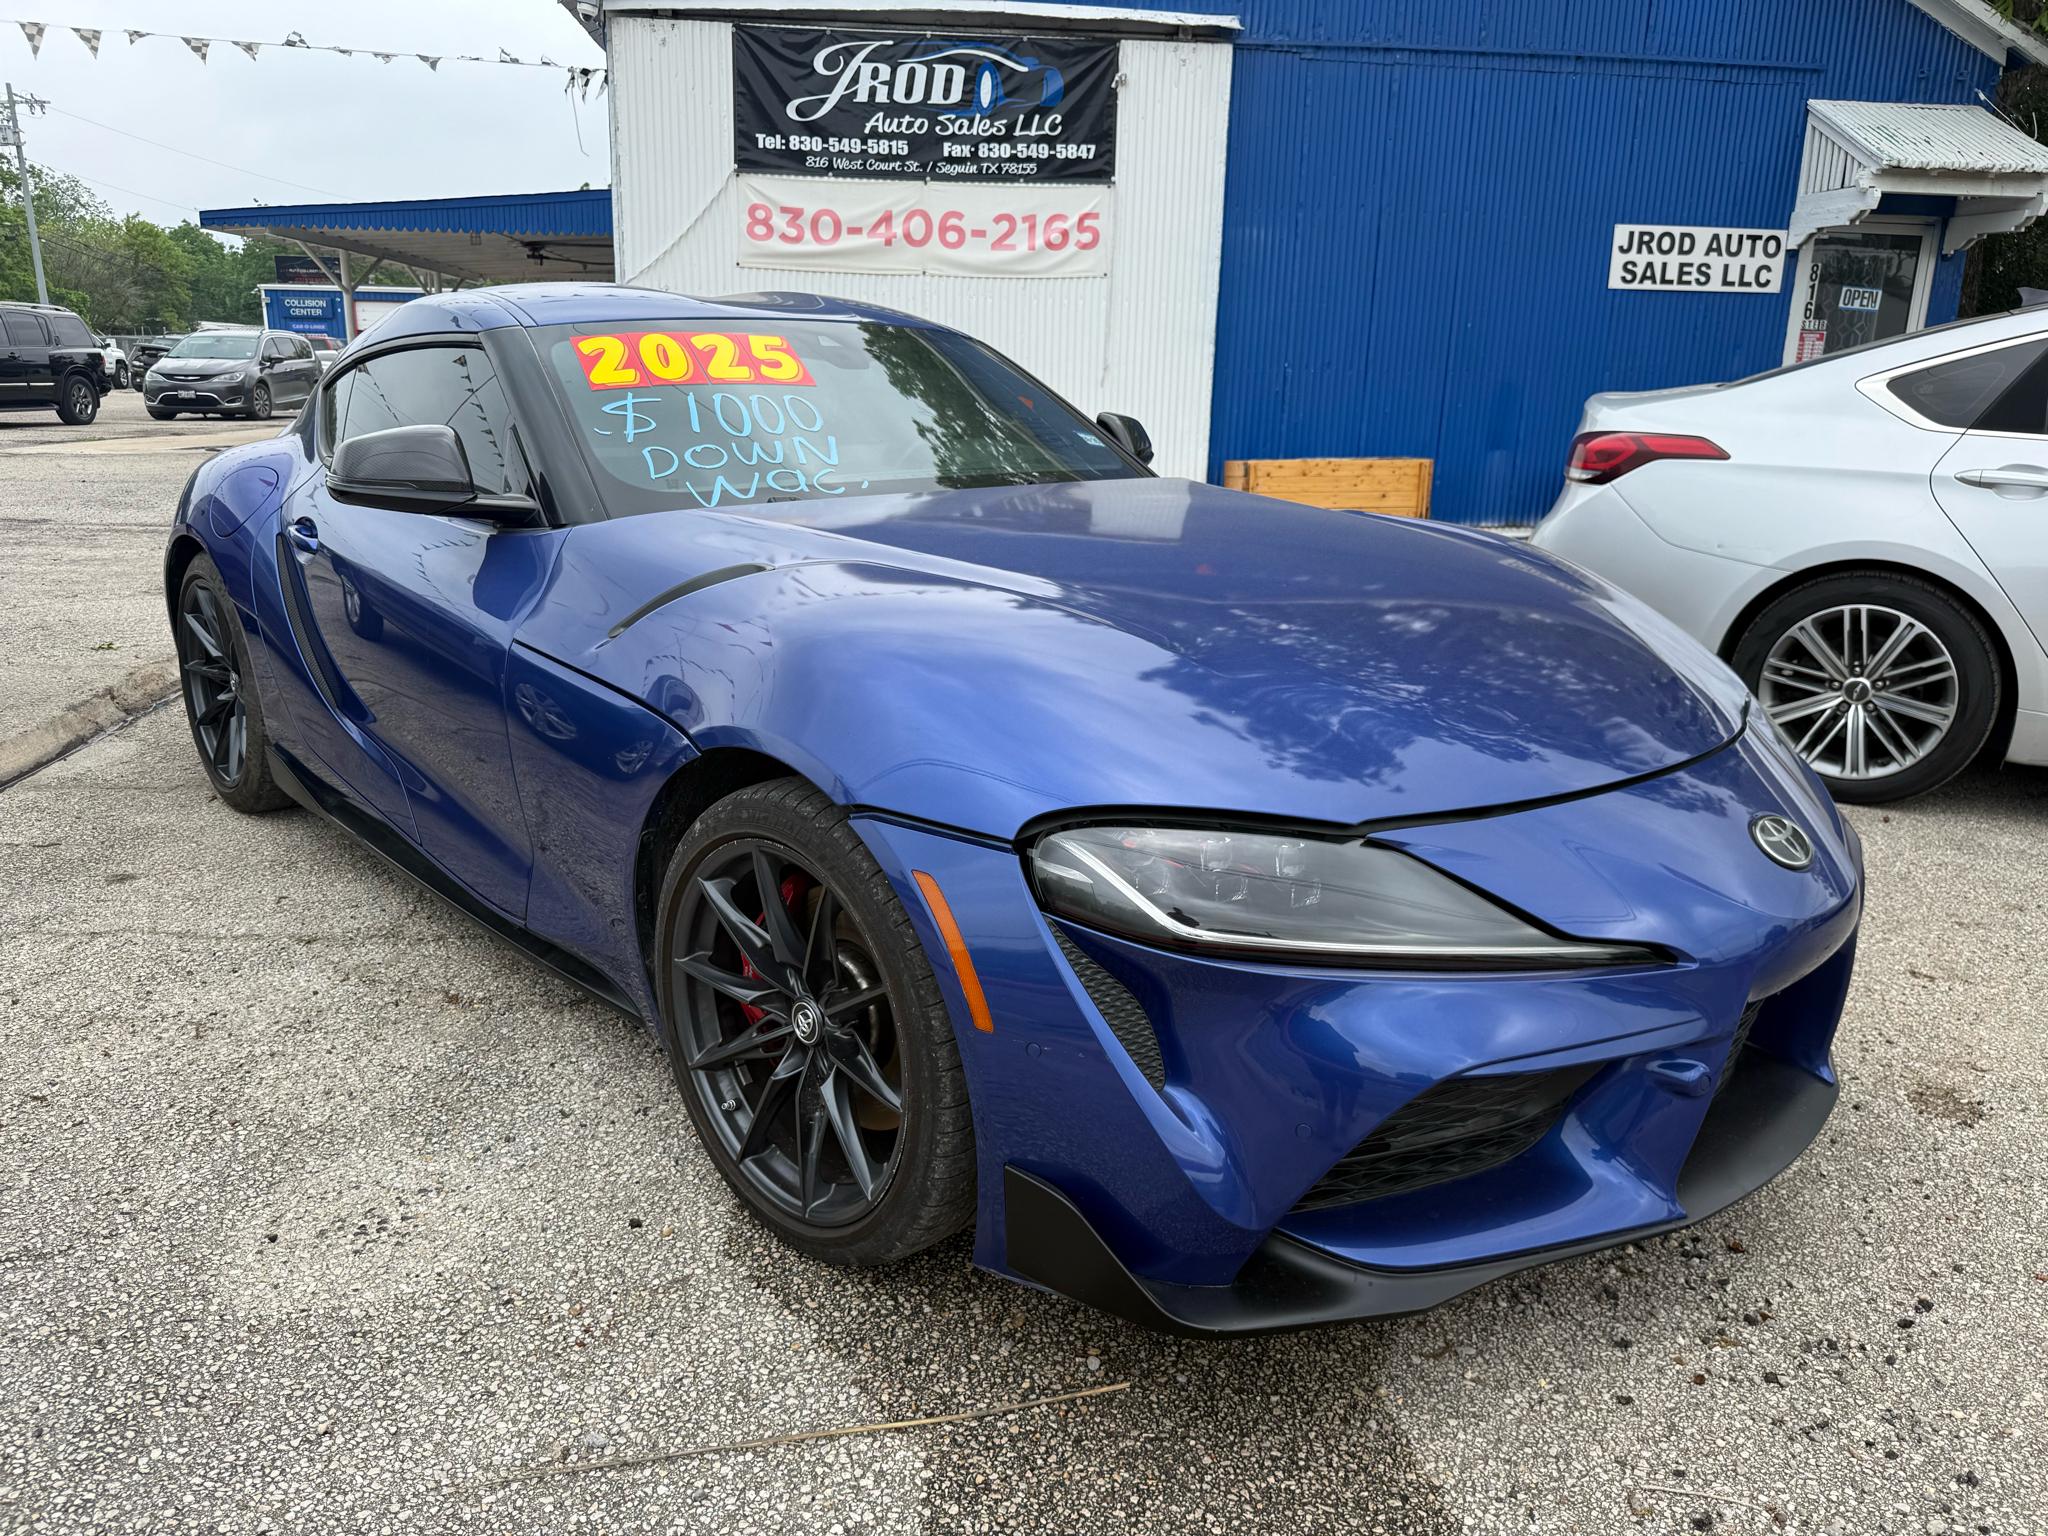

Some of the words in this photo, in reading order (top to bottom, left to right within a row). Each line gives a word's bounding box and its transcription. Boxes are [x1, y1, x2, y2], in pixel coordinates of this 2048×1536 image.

[864, 112, 929, 134] Auto
[935, 113, 1007, 136] Sales
[1013, 114, 1062, 136] LLC
[755, 133, 786, 149] Tel:
[789, 135, 909, 155] 830-549-5815
[978, 143, 1096, 159] 830-549-5847
[805, 156, 828, 168] 816
[833, 157, 863, 170] West
[866, 159, 902, 172] Court
[904, 160, 923, 172] St.
[935, 162, 978, 176] Seguin
[980, 163, 999, 174] TX
[1000, 163, 1037, 175] 78155
[746, 203, 1100, 251] 830-406-2165
[1618, 231, 1696, 256] JROD
[1704, 233, 1781, 259] AUTO
[1620, 260, 1712, 286] SALES
[1721, 263, 1773, 288] LLC
[284, 299, 326, 308] COLLISION
[1804, 263, 1820, 320] 816
[1842, 288, 1879, 309] OPEN
[290, 308, 322, 316] CENTER
[578, 333, 804, 386] 2025
[642, 436, 839, 480] DOWN
